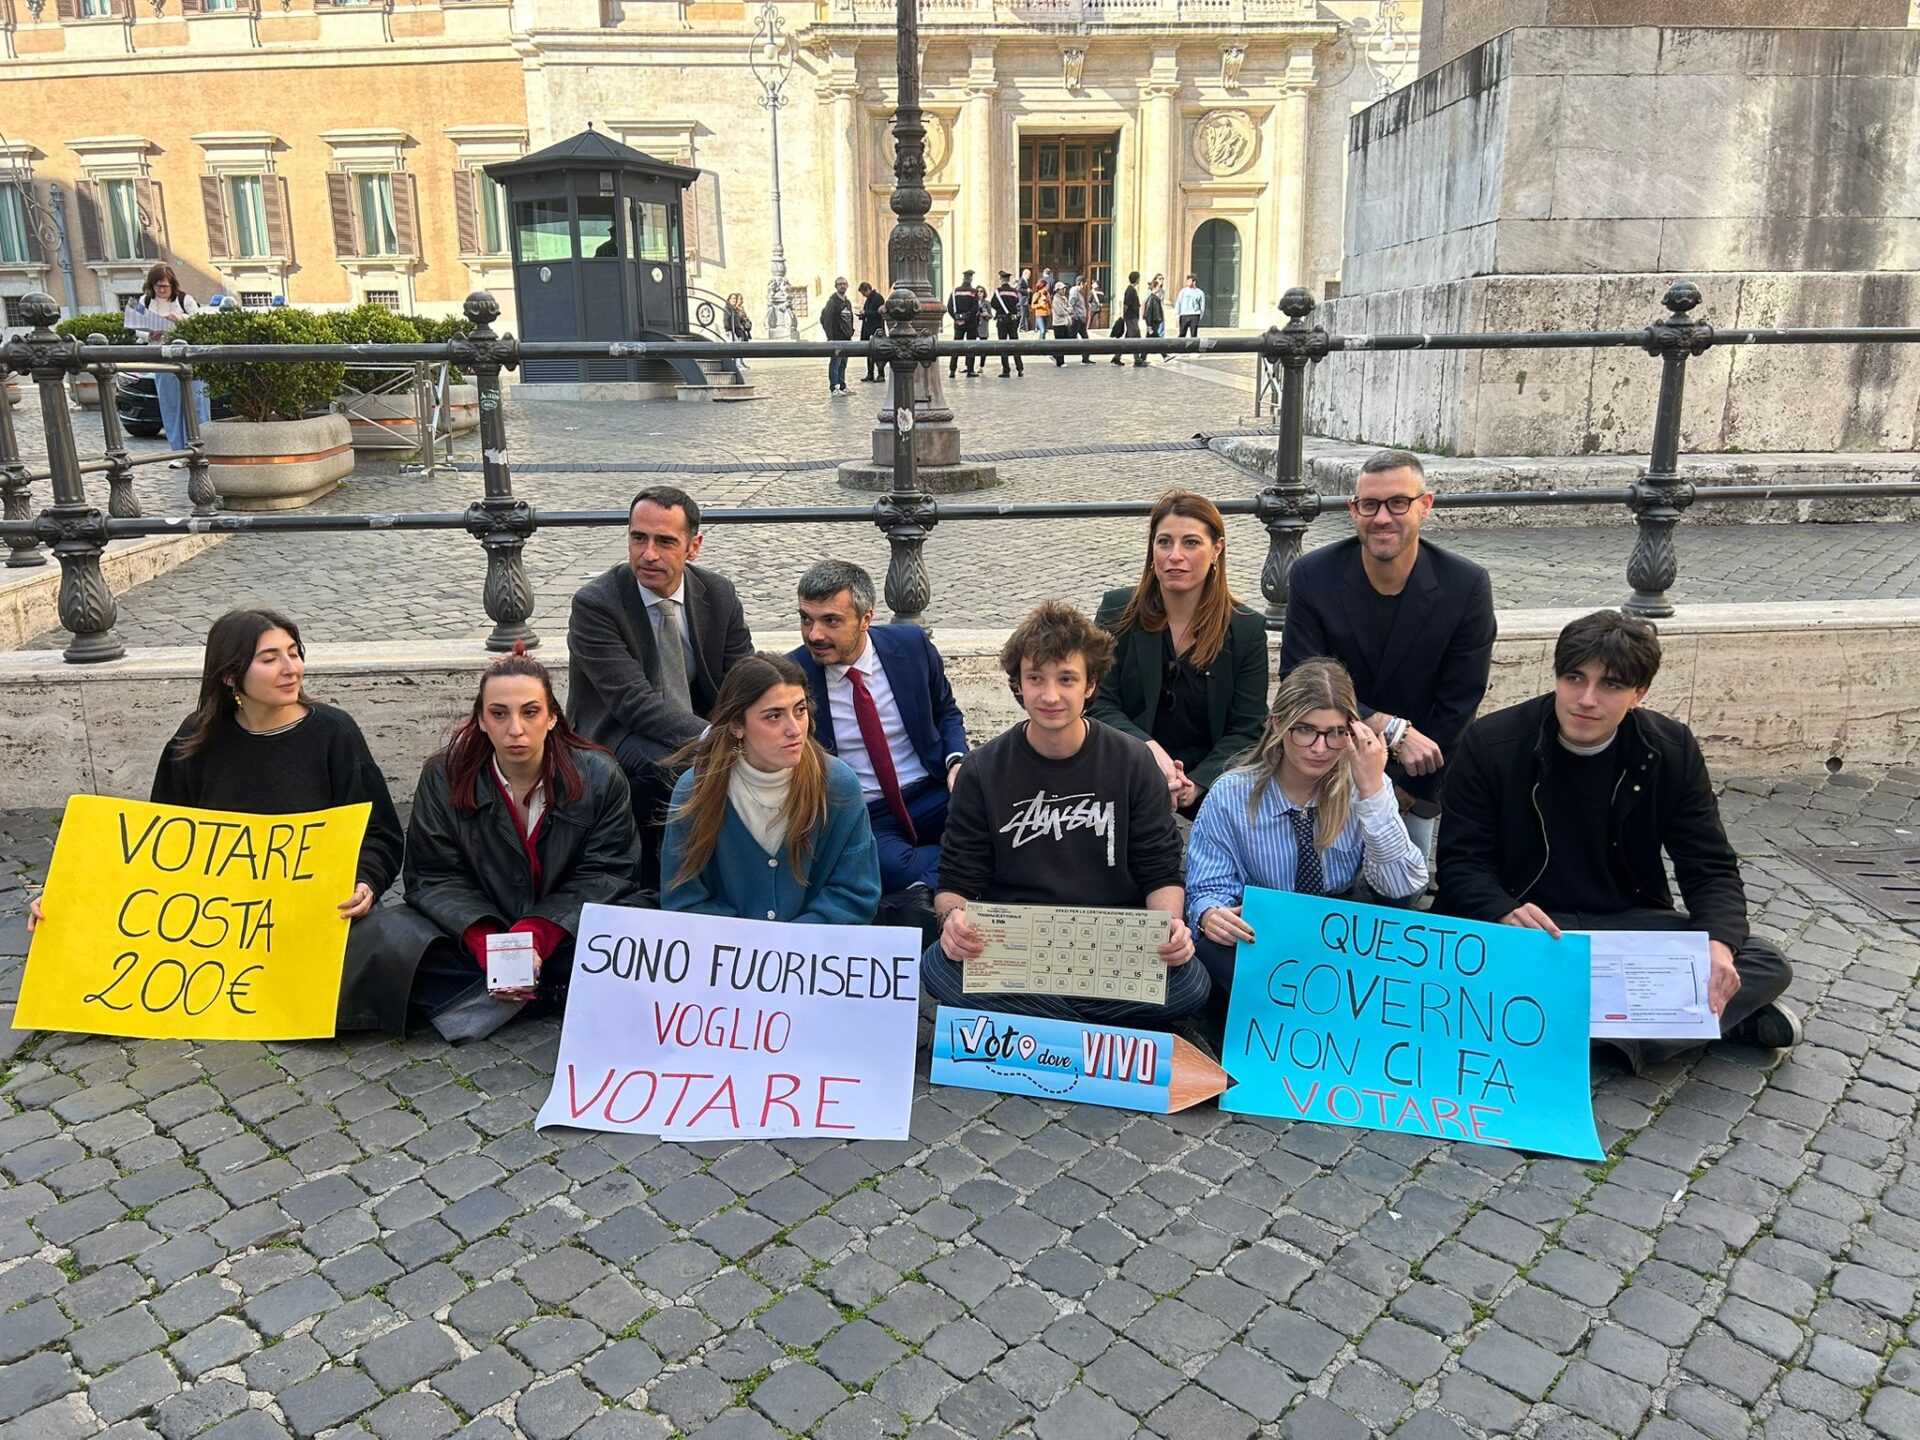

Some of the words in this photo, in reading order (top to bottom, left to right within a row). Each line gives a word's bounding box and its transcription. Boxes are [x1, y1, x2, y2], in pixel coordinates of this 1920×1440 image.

[118, 812, 326, 881] VOTARE
[117, 888, 274, 953] COSTA
[1320, 911, 1486, 976] QUESTO
[83, 951, 264, 1015] 200€
[581, 934, 690, 984] SONO
[710, 944, 917, 1001] FUORISEDE
[654, 1001, 791, 1053] VOGLIO
[1267, 959, 1546, 1047] GOVERNO
[1038, 1048, 1072, 1068] dove
[1082, 1030, 1158, 1085] VIVO
[1245, 1017, 1361, 1076] NON
[1383, 1041, 1422, 1088] CI
[1457, 1048, 1516, 1104] FA
[568, 1064, 861, 1130] VOTARE
[1282, 1077, 1510, 1144] VOTARE
